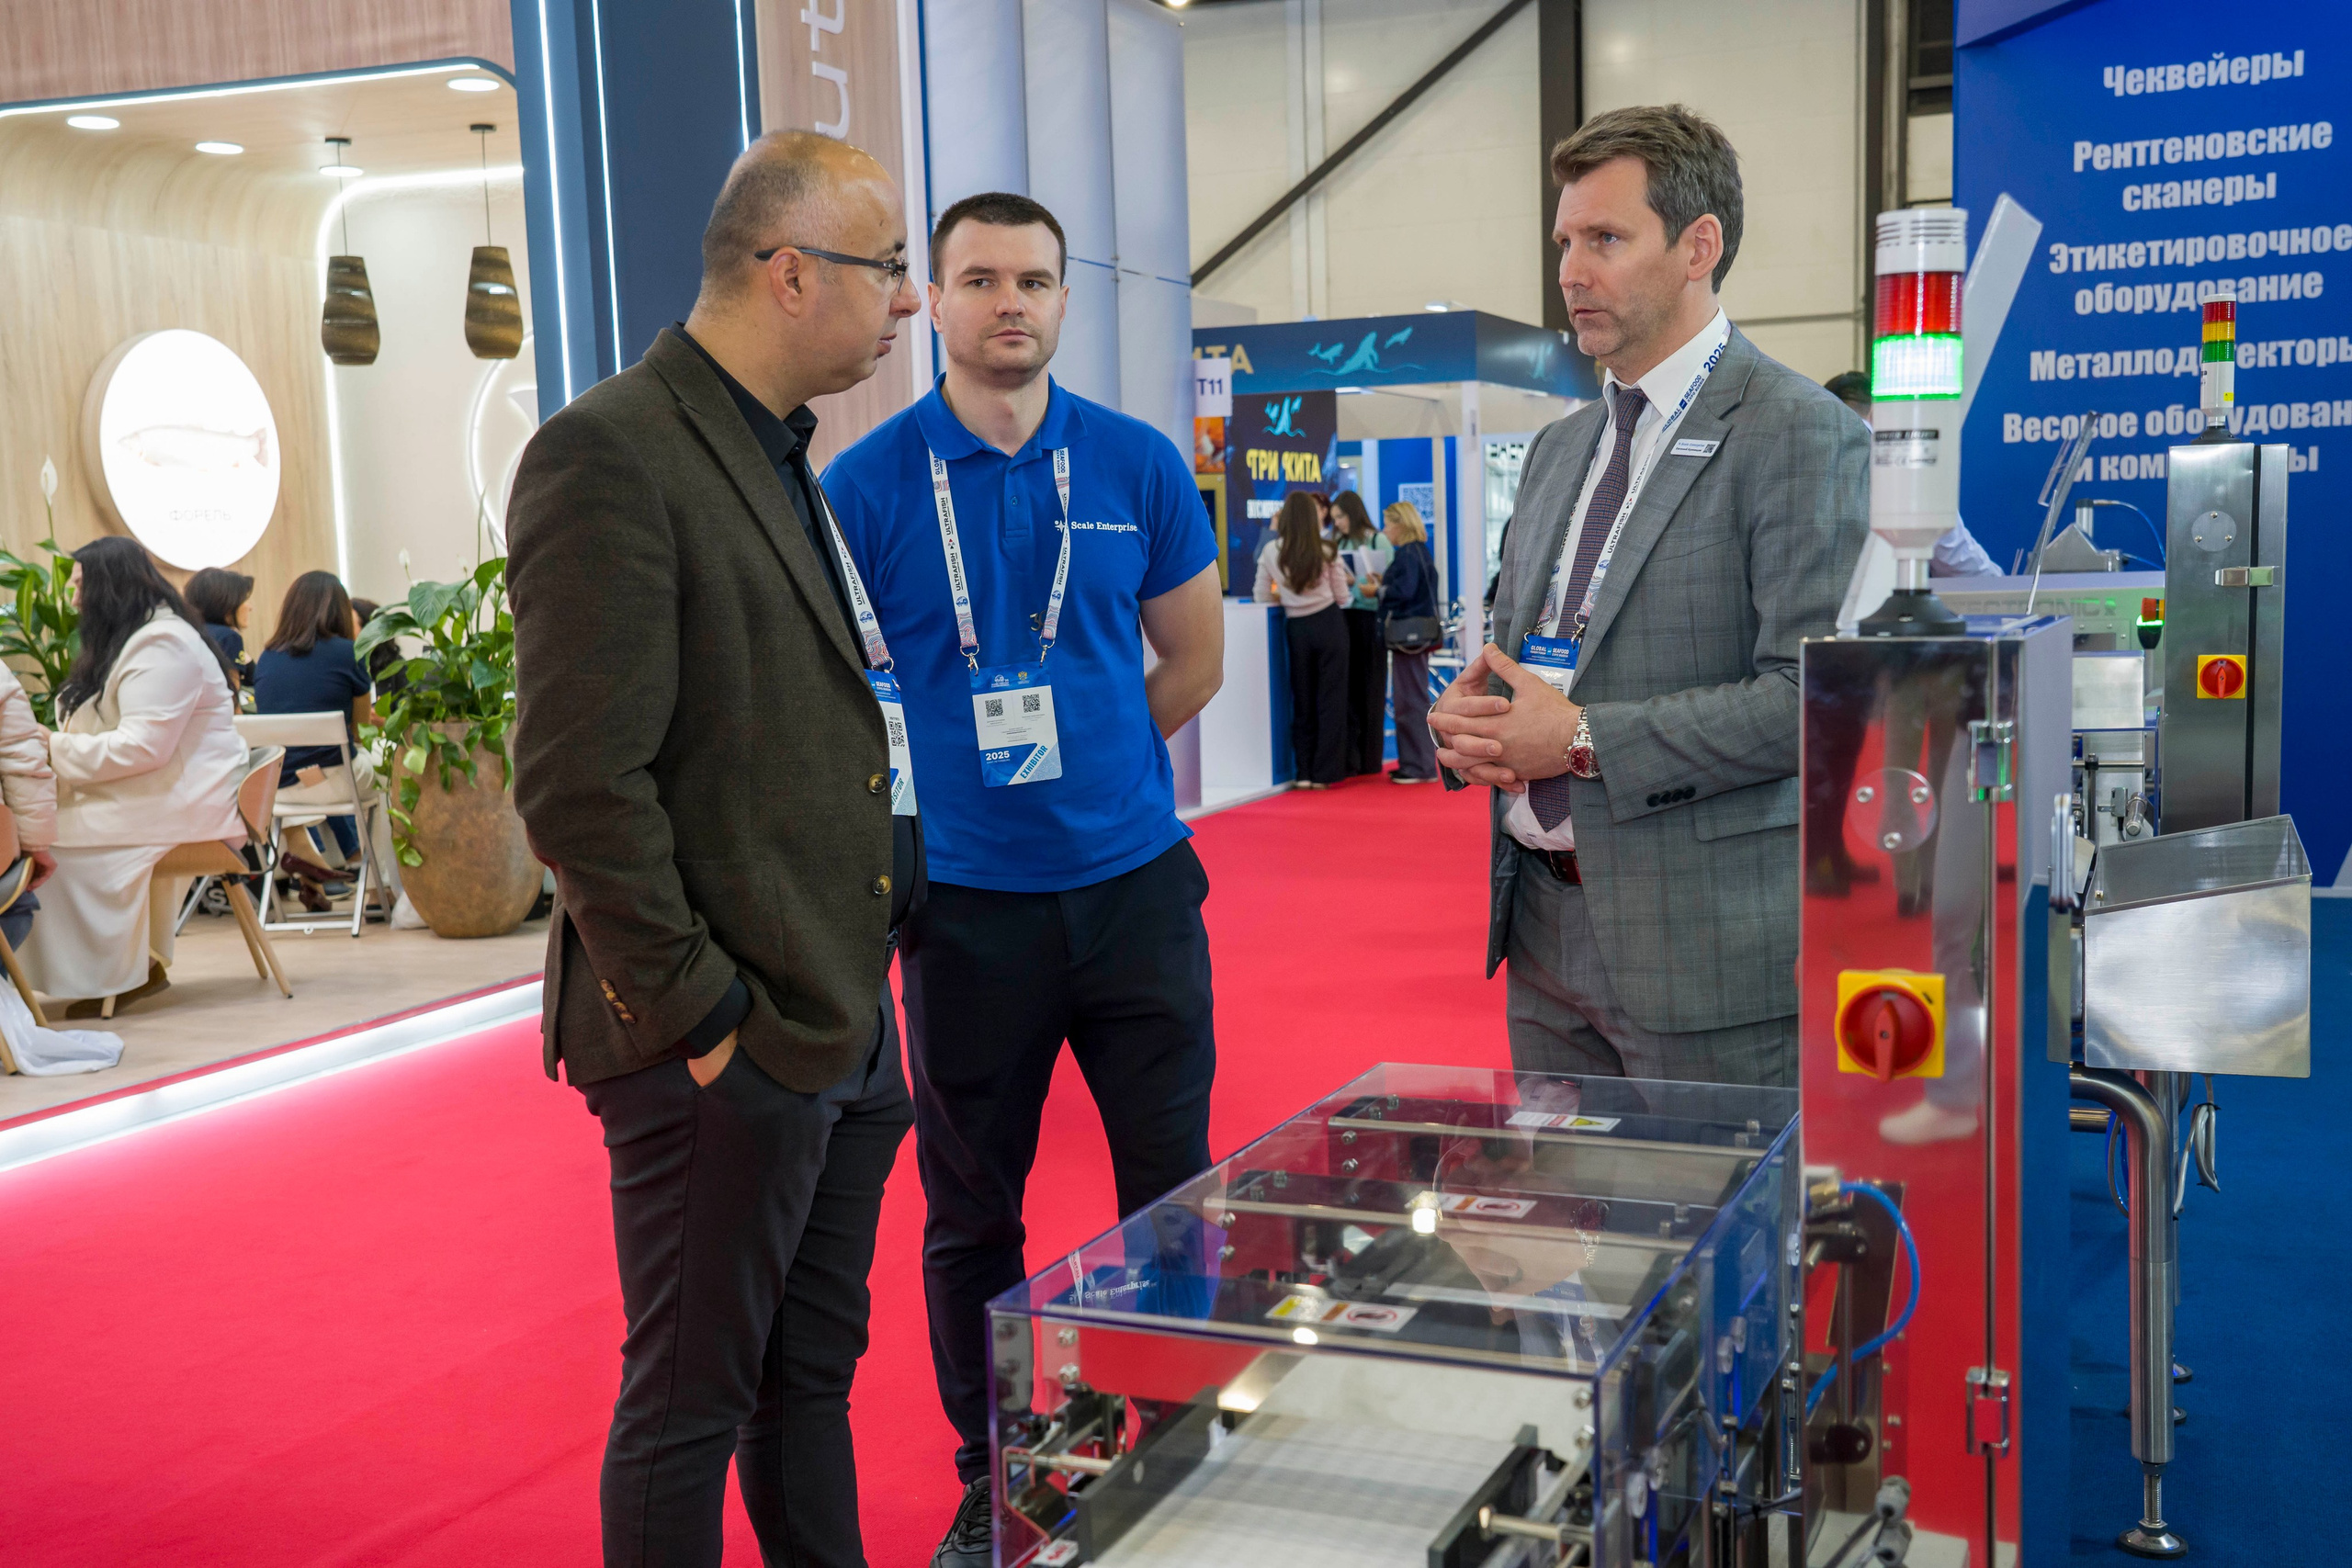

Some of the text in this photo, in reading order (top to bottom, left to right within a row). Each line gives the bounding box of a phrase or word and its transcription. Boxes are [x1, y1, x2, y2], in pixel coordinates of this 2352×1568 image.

[2103, 50, 2304, 96] Чеквейеры
[2074, 121, 2333, 172] Рентгеновские
[2122, 172, 2277, 211] сканеры
[2049, 223, 2352, 275] Этикетировочное
[2075, 271, 2324, 315] оборудование
[1703, 343, 1726, 373] 2025
[2030, 336, 2352, 381] Металлодектор
[1196, 378, 1223, 396] T11
[1684, 374, 1702, 400] SEAFOOD
[2144, 400, 2352, 436] обоудован
[1246, 447, 1322, 483] ТРИ КИТА
[940, 497, 950, 536] ULTRAFISH
[1070, 521, 1138, 533] Scale Enterprise
[1607, 513, 1627, 554] ULTRAFISH
[845, 562, 862, 605] ULTRAFISH
[950, 552, 961, 592] ULTRAFISH
[1057, 547, 1068, 586] ULTRAFISH
[985, 750, 1011, 761] 2025
[1020, 745, 1048, 779] EXHIBITOR
